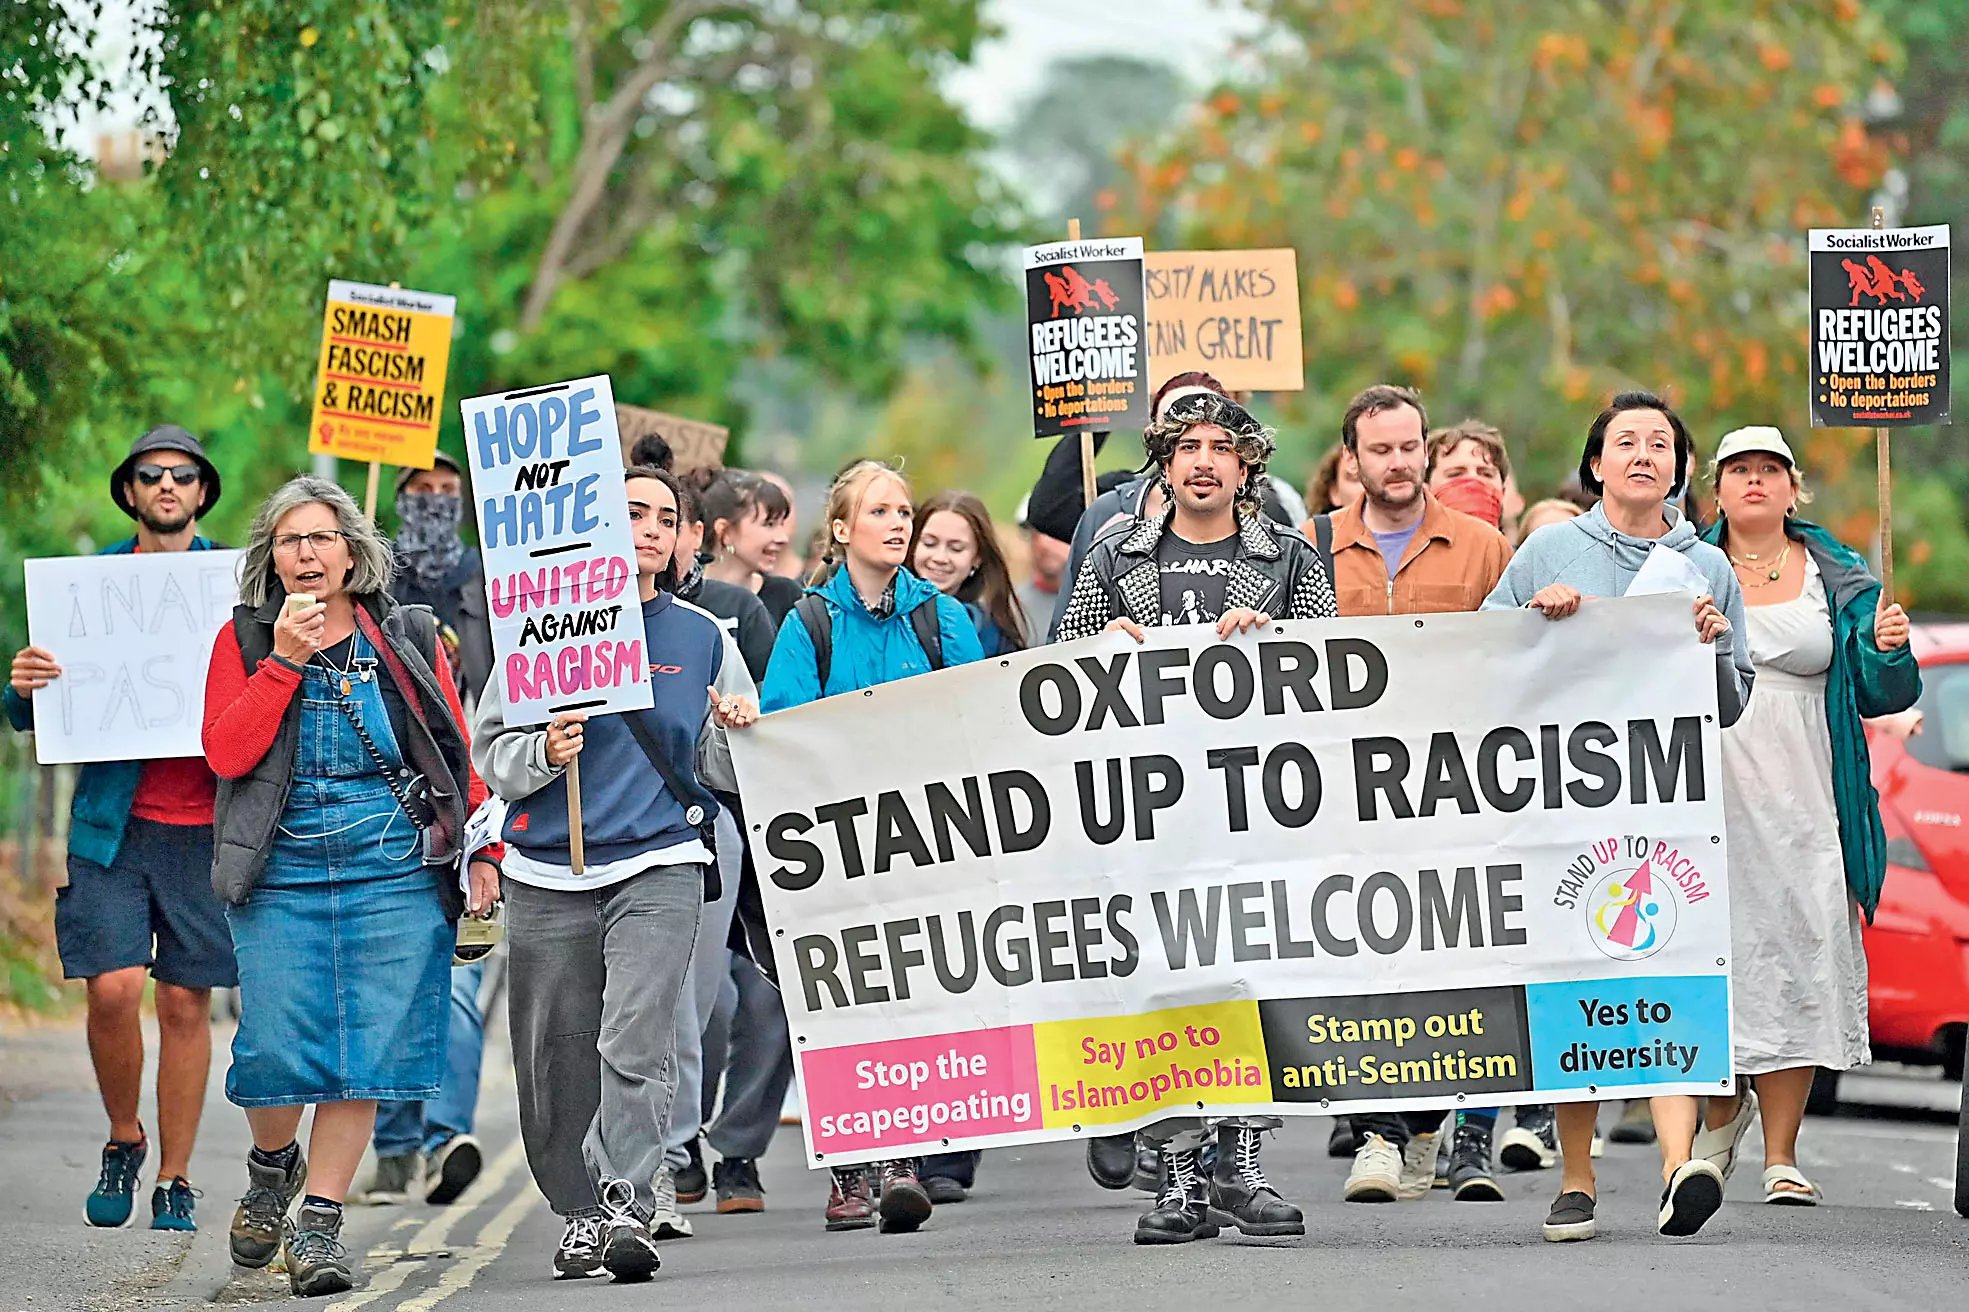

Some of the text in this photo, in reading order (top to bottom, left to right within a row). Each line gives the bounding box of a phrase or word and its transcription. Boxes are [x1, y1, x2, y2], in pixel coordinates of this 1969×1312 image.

[1035, 244, 1126, 264] Socialist Worker
[1827, 233, 1934, 248] Socialist Worker
[1198, 268, 1276, 302] MAKES
[332, 308, 412, 343] SMASH
[1032, 315, 1138, 355] REFUGEES
[1197, 316, 1283, 361] GREAT
[1819, 305, 1941, 342] REFUGEES
[327, 345, 424, 383] FASCISM
[1033, 346, 1138, 385] WELCOME
[1817, 337, 1940, 374] WELCOME
[322, 382, 434, 421] & RACISM
[1043, 379, 1134, 401] Open the borders
[1829, 372, 1936, 392] Open the borders
[1830, 391, 1930, 410] No deportations
[1045, 397, 1128, 417] No deportations
[474, 387, 603, 470] HOPE
[514, 459, 570, 492] NOT
[483, 472, 610, 549] HATE.
[491, 555, 629, 619] UNITED
[518, 604, 622, 647] AGAINST
[505, 638, 648, 705] RACISM.
[1019, 637, 1389, 736] OXFORD
[765, 716, 1706, 891] STAND UP TO RACISM
[1553, 835, 1710, 910] STAND UP TO RACISM
[793, 863, 1528, 1012] REFUGEES WELCOME
[1307, 1006, 1484, 1048] Stamp out
[1578, 998, 1672, 1027] Yes to
[1081, 1023, 1221, 1071] Say no to
[1559, 1038, 1699, 1076] diversity
[855, 1048, 988, 1091] Stop the
[1050, 1056, 1262, 1112] Islamophobia
[1282, 1050, 1517, 1089] anti-Semitism
[820, 1089, 1031, 1138] scapegoating
